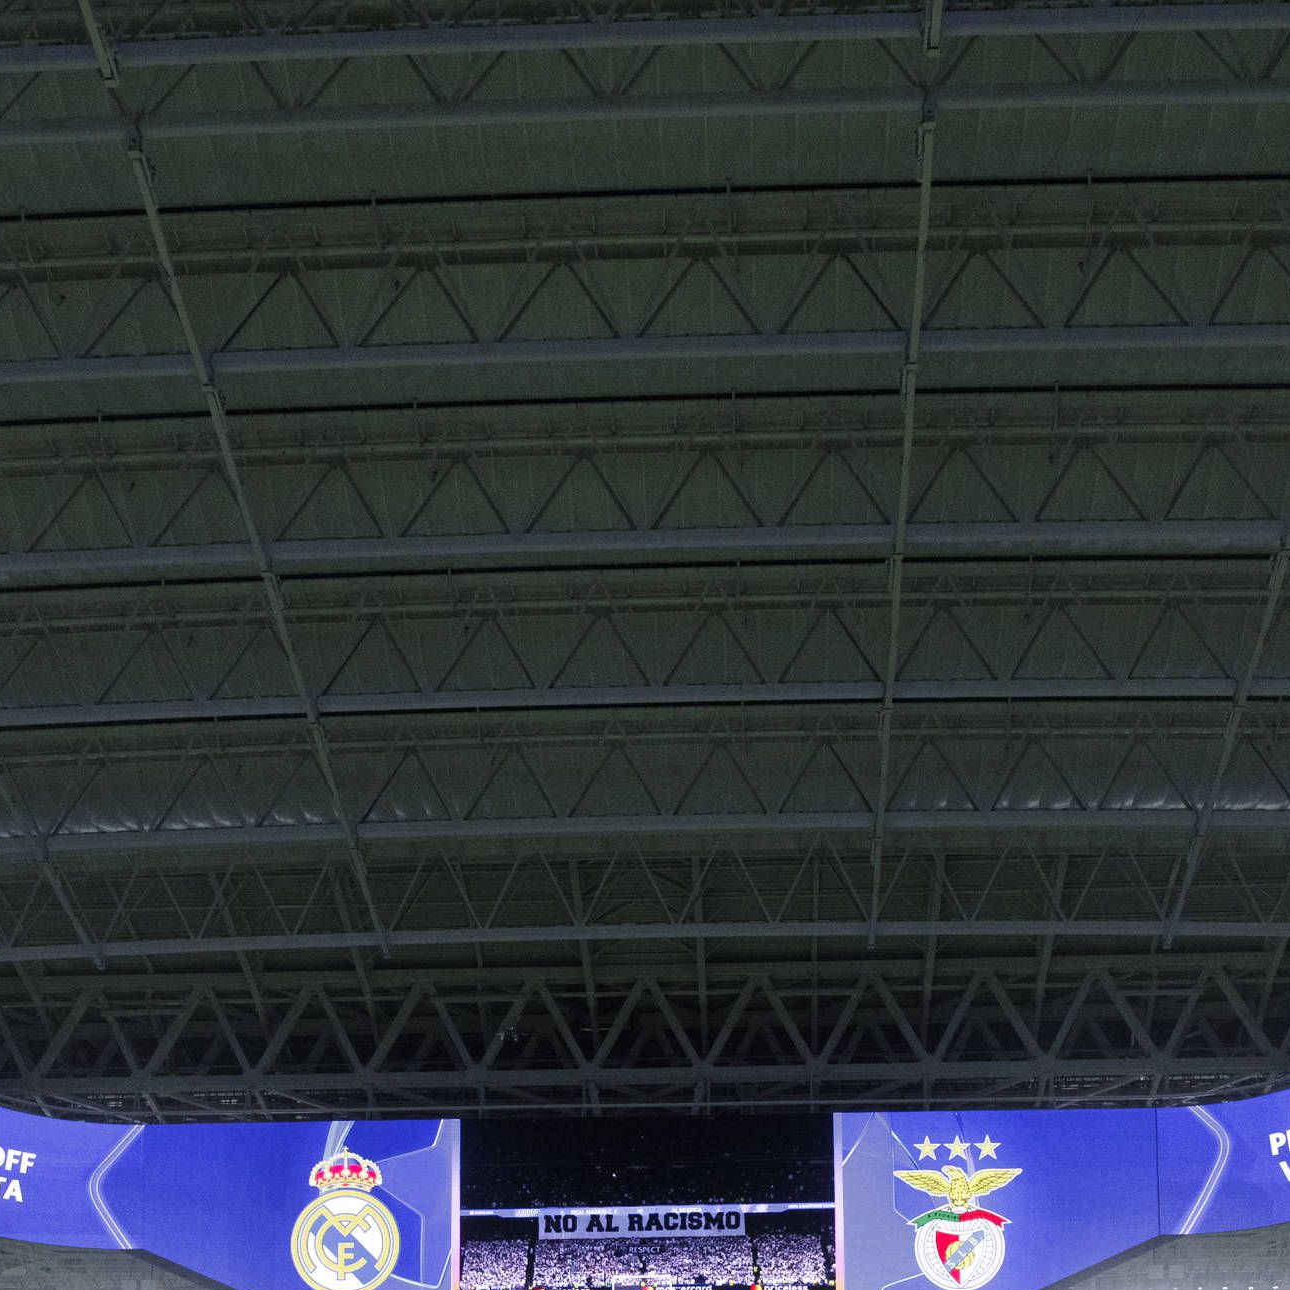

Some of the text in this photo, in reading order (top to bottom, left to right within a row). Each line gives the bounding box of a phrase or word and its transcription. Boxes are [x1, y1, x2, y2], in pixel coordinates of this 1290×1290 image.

[543, 1210, 742, 1233] NO AL RACISMO
